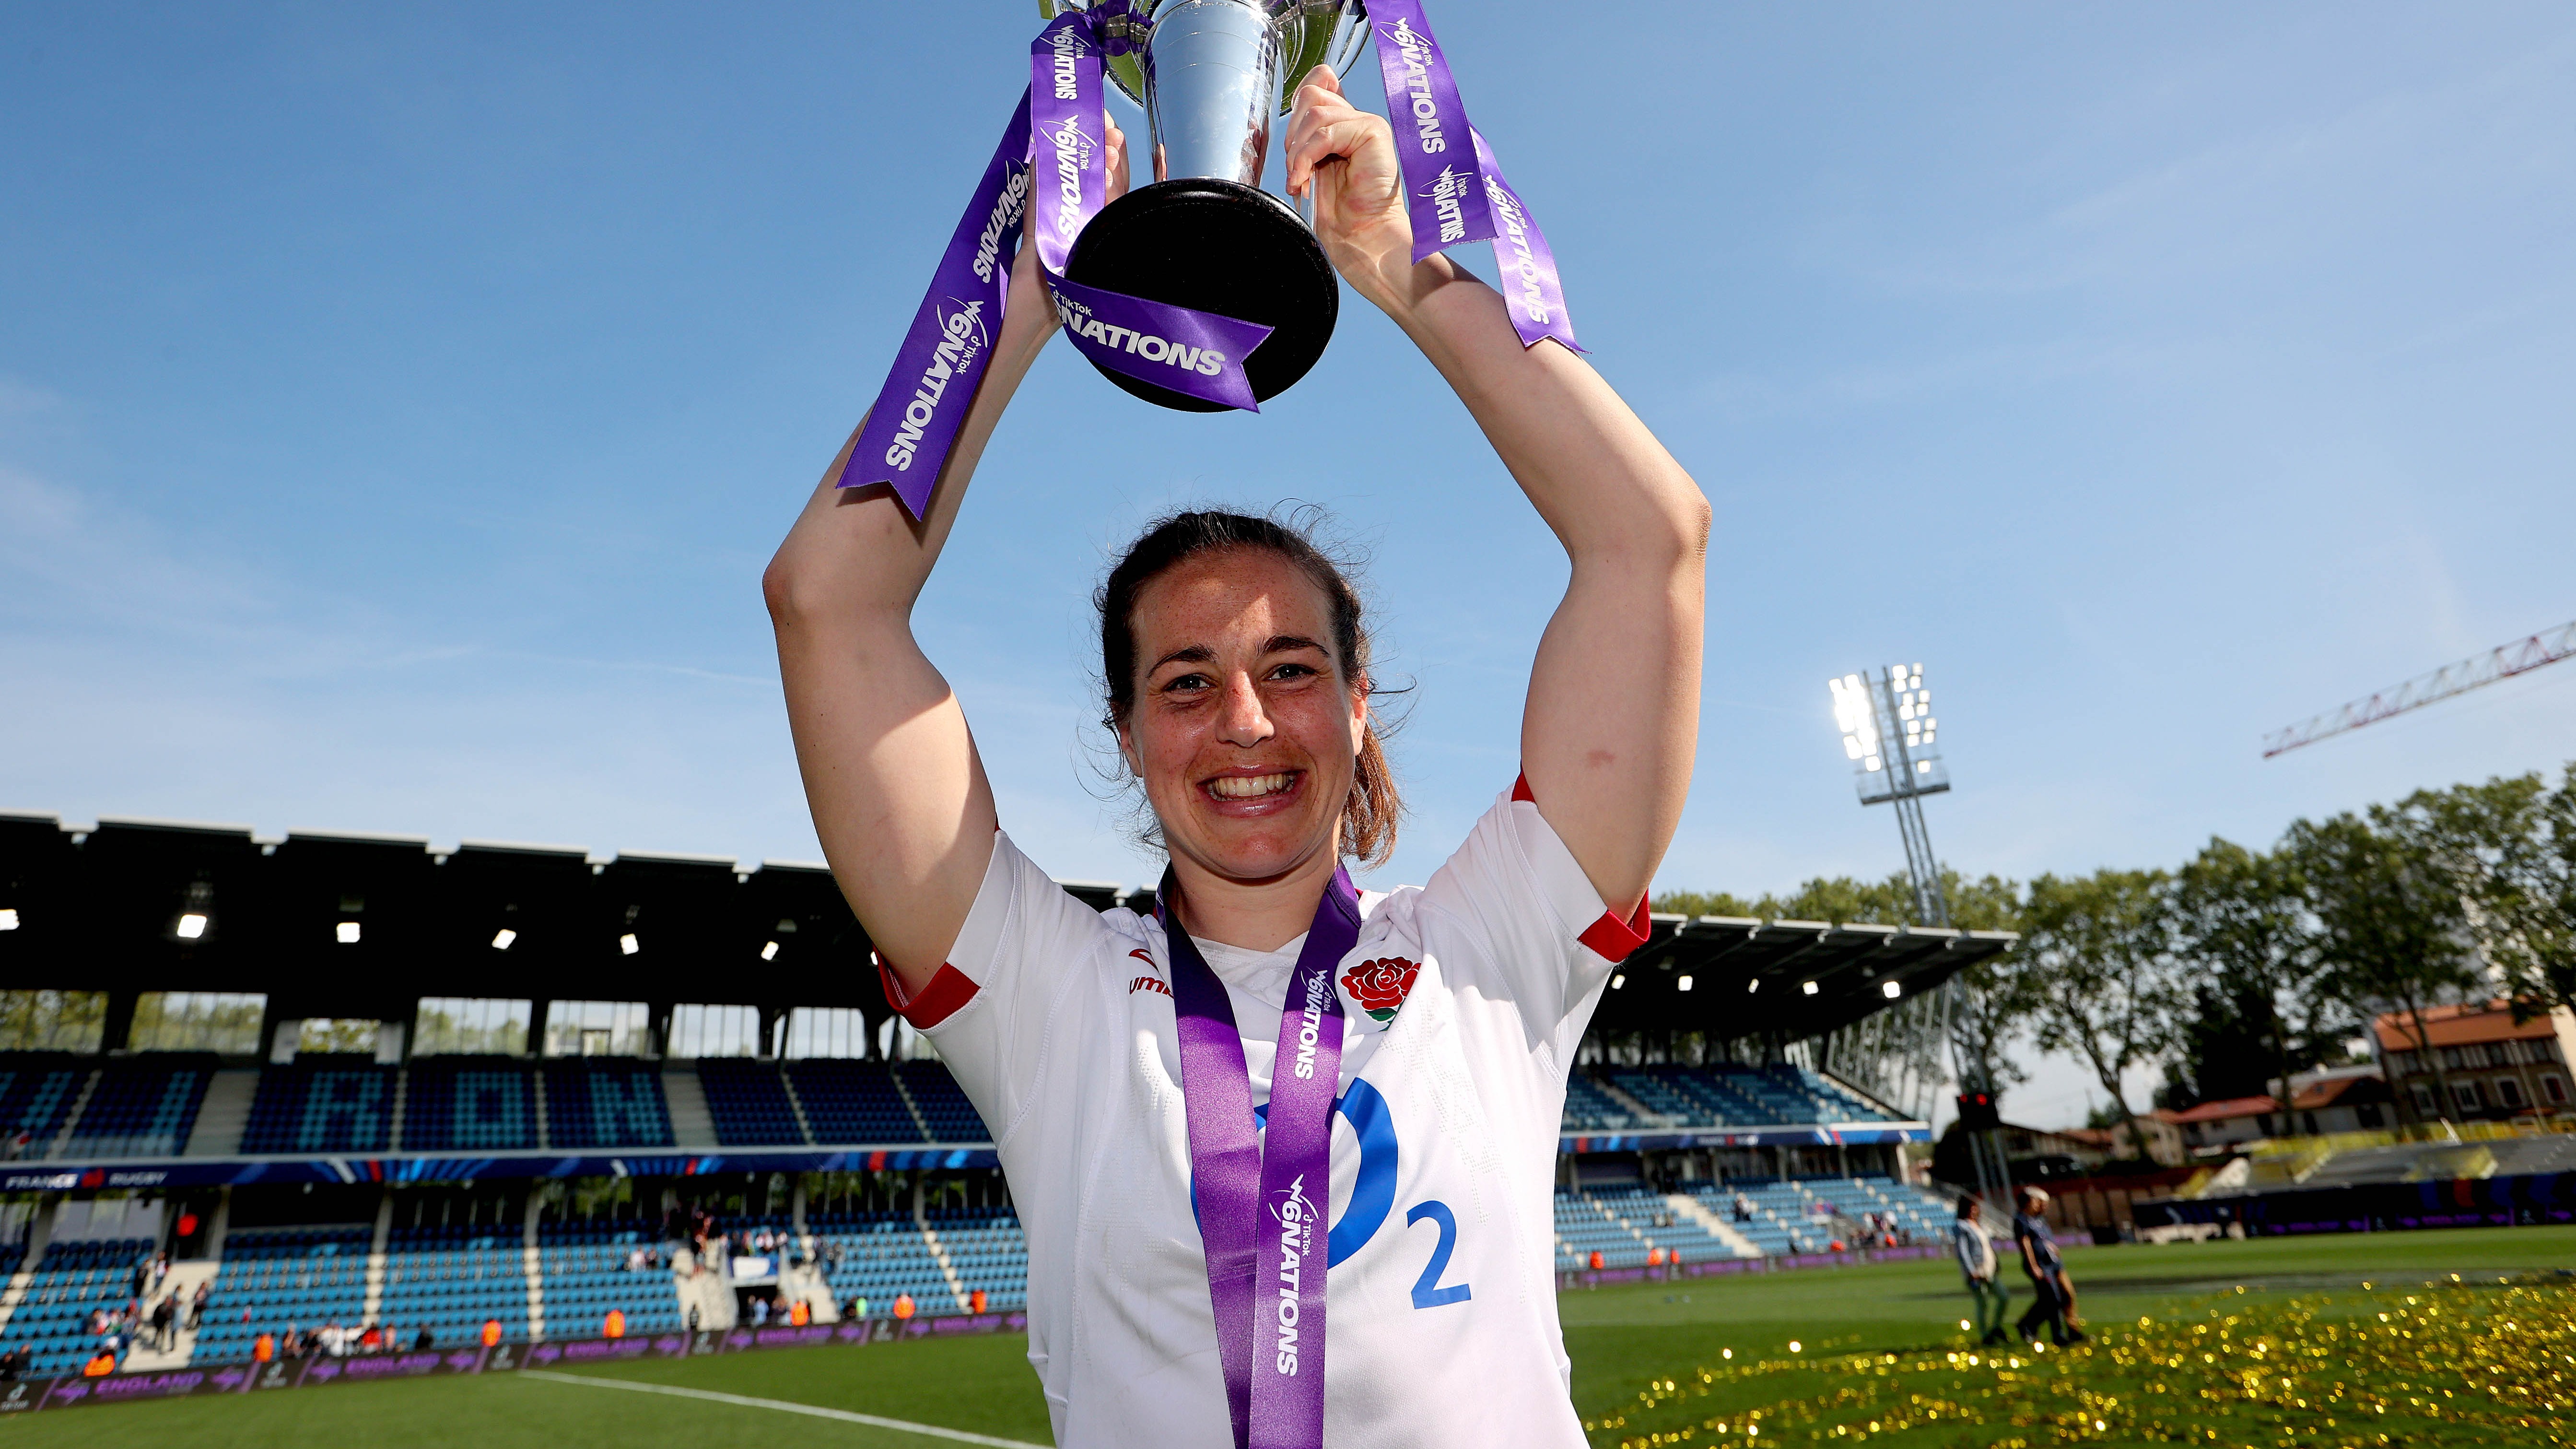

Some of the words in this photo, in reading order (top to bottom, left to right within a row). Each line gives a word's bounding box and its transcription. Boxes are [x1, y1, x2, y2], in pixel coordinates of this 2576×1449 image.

[1421, 46, 1435, 66] TikTok
[1080, 149, 1093, 171] TikTok
[1007, 206, 1023, 228] TikTok
[1060, 294, 1092, 317] TikTok
[956, 345, 978, 375] TikTok
[1323, 994, 1332, 1012] TikTok
[4, 1173, 79, 1190] FRANCE
[108, 1170, 168, 1187] RUGBY
[1302, 1225, 1312, 1256] TikTok
[94, 1371, 205, 1394] ENGLAND
